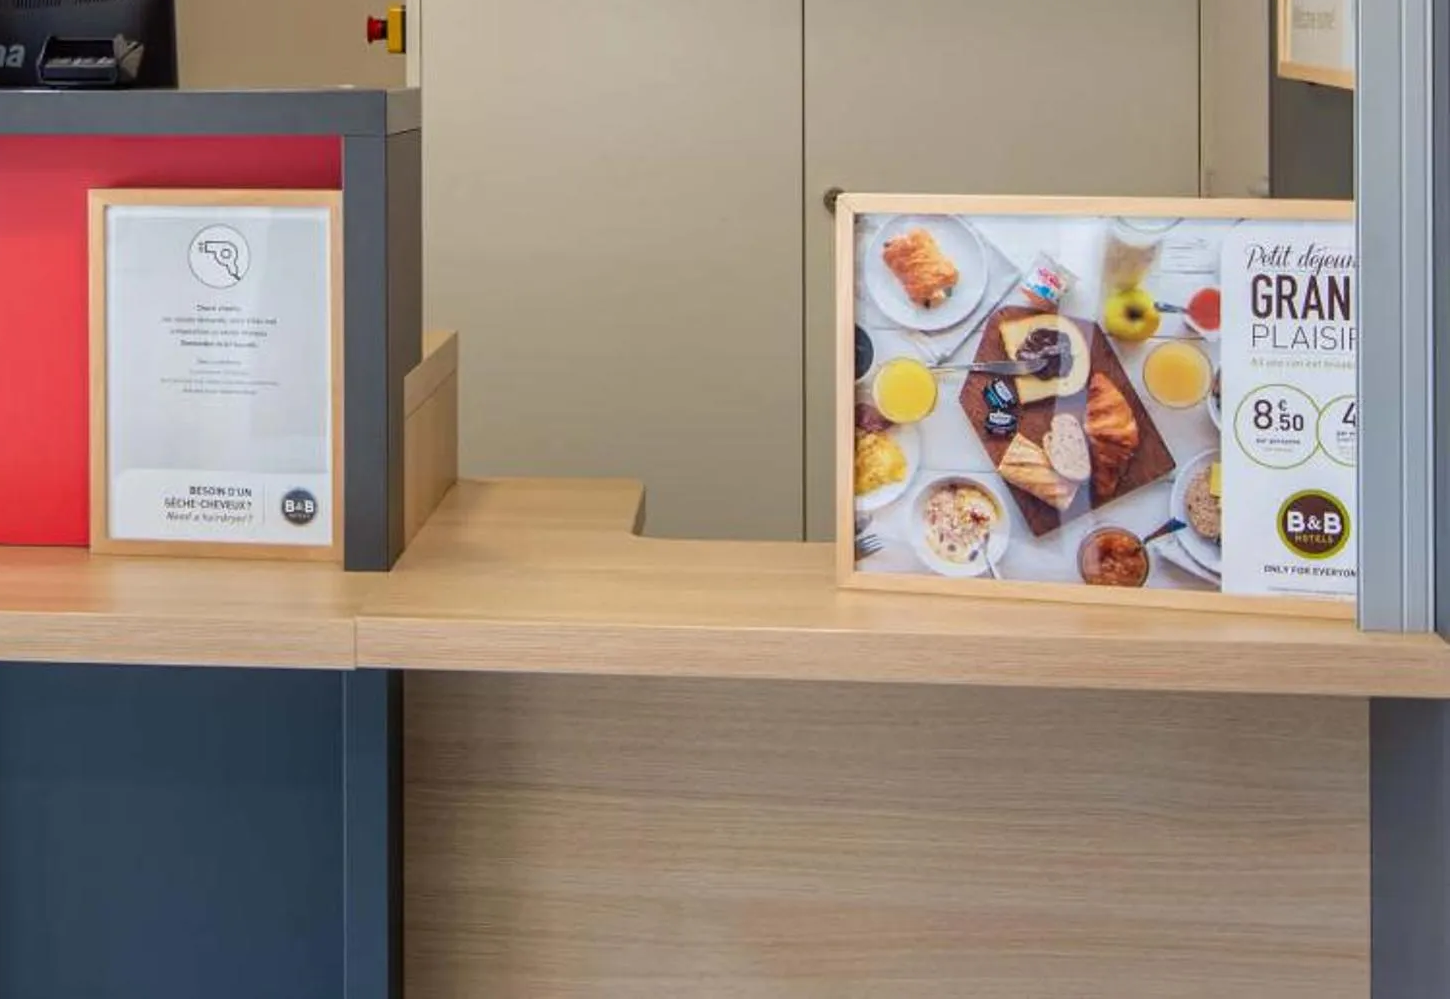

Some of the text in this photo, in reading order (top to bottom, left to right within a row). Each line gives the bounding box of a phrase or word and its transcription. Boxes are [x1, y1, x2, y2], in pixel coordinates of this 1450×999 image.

[1247, 243, 1292, 270] Petit
[1251, 273, 1351, 321] GRAN
[1253, 399, 1273, 430] 8
[189, 486, 225, 496] BESOIN
[285, 499, 314, 513] B&B
[1286, 510, 1342, 534] B&B
[1294, 533, 1334, 544] HOTELS
[1263, 565, 1289, 575] ONLY
[1291, 566, 1310, 575] FOR
